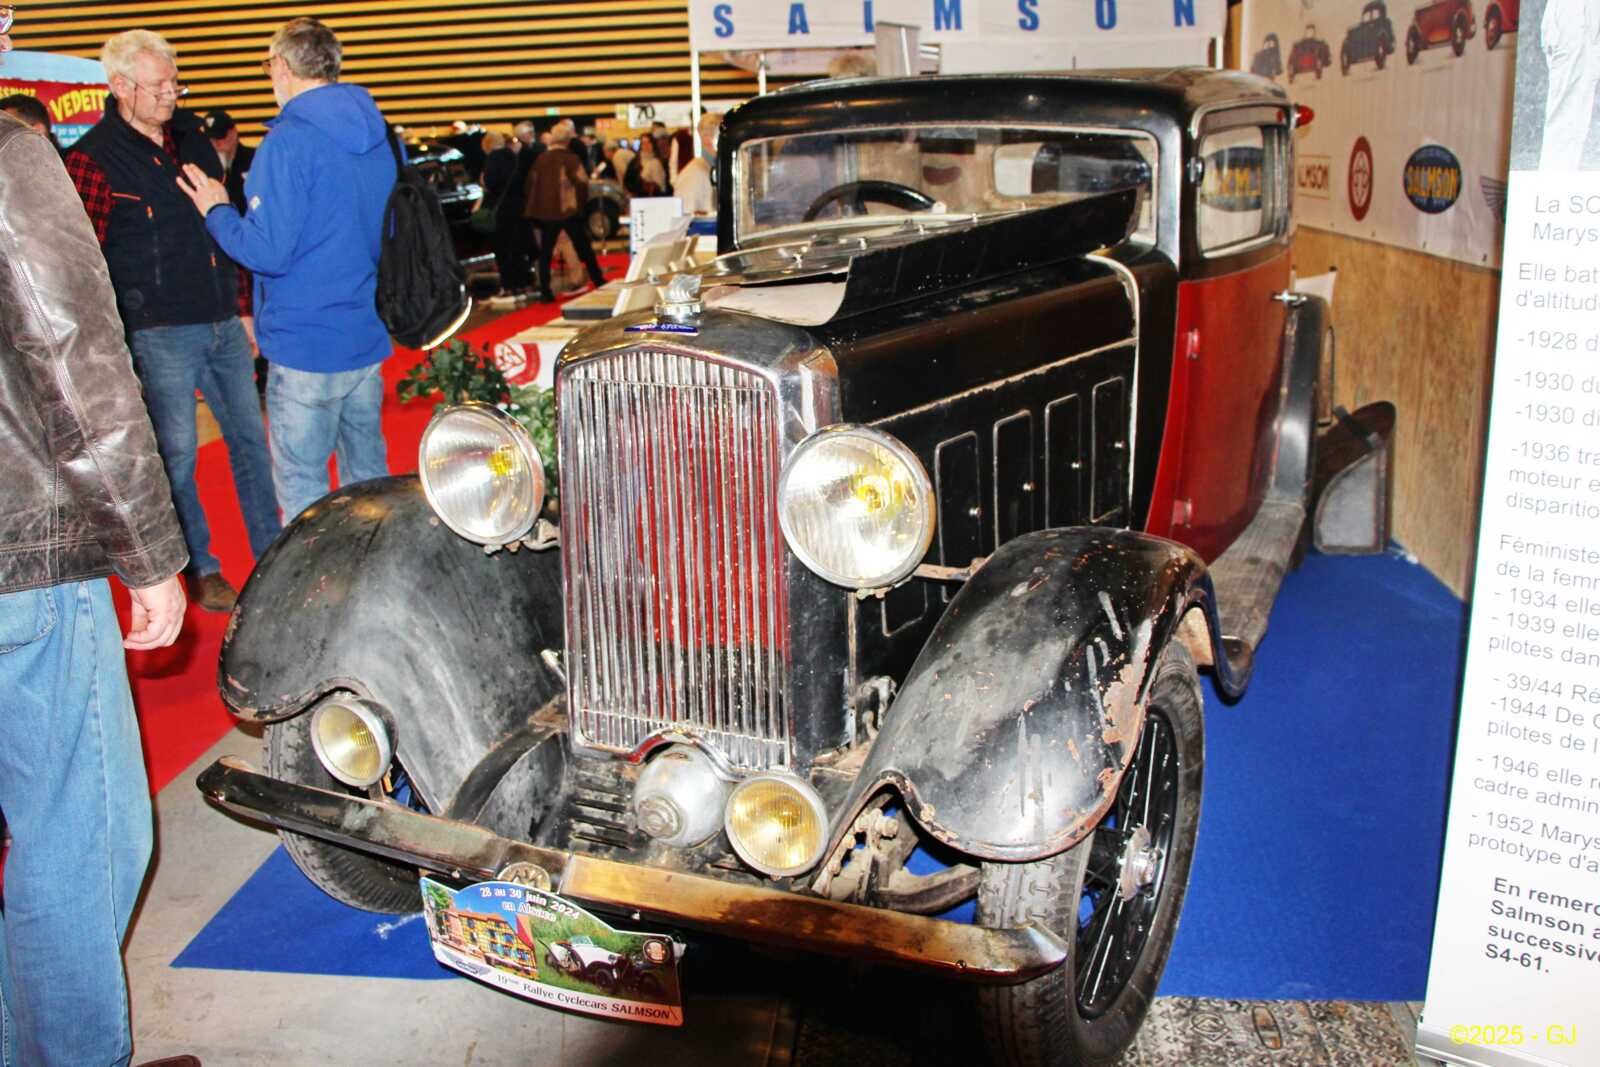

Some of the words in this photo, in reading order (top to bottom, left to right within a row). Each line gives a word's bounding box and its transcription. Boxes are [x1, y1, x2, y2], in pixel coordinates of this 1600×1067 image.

[1535, 195, 1560, 213] La
[1533, 222, 1599, 246] Marys
[1519, 262, 1557, 281] Elle
[1564, 265, 1598, 283] bat
[1516, 290, 1600, 311] d'altitud
[1508, 467, 1582, 490] moteur
[1506, 492, 1600, 518] disparitio
[1500, 534, 1600, 564] Féministe
[1496, 560, 1521, 578] de
[1528, 564, 1545, 582] la
[1510, 588, 1557, 609] 1934
[1566, 597, 1600, 616] elle
[1508, 612, 1556, 634] 1939
[1562, 622, 1600, 641] elle
[1488, 636, 1553, 660] pilotes
[1560, 647, 1600, 667] dan
[1506, 672, 1563, 697] 39/44
[1555, 706, 1585, 726] De
[1487, 720, 1553, 745] pilotes
[1560, 733, 1586, 751] de
[1492, 754, 1539, 777] 1946
[1546, 768, 1583, 786] elle
[1474, 776, 1529, 800] cadre
[1535, 791, 1599, 814] admin
[1487, 811, 1535, 835] 1952
[1468, 832, 1562, 865] prototype
[1568, 854, 1599, 873] d'a
[525, 891, 547, 907] juin
[1494, 877, 1521, 897] En
[1491, 899, 1585, 936] Salmson
[1488, 924, 1600, 962] successiv
[1485, 943, 1549, 973] S4-61.
[523, 983, 554, 1002] Rallye
[557, 993, 608, 1011] Cyclecars
[611, 1004, 670, 1020] SALMSON
